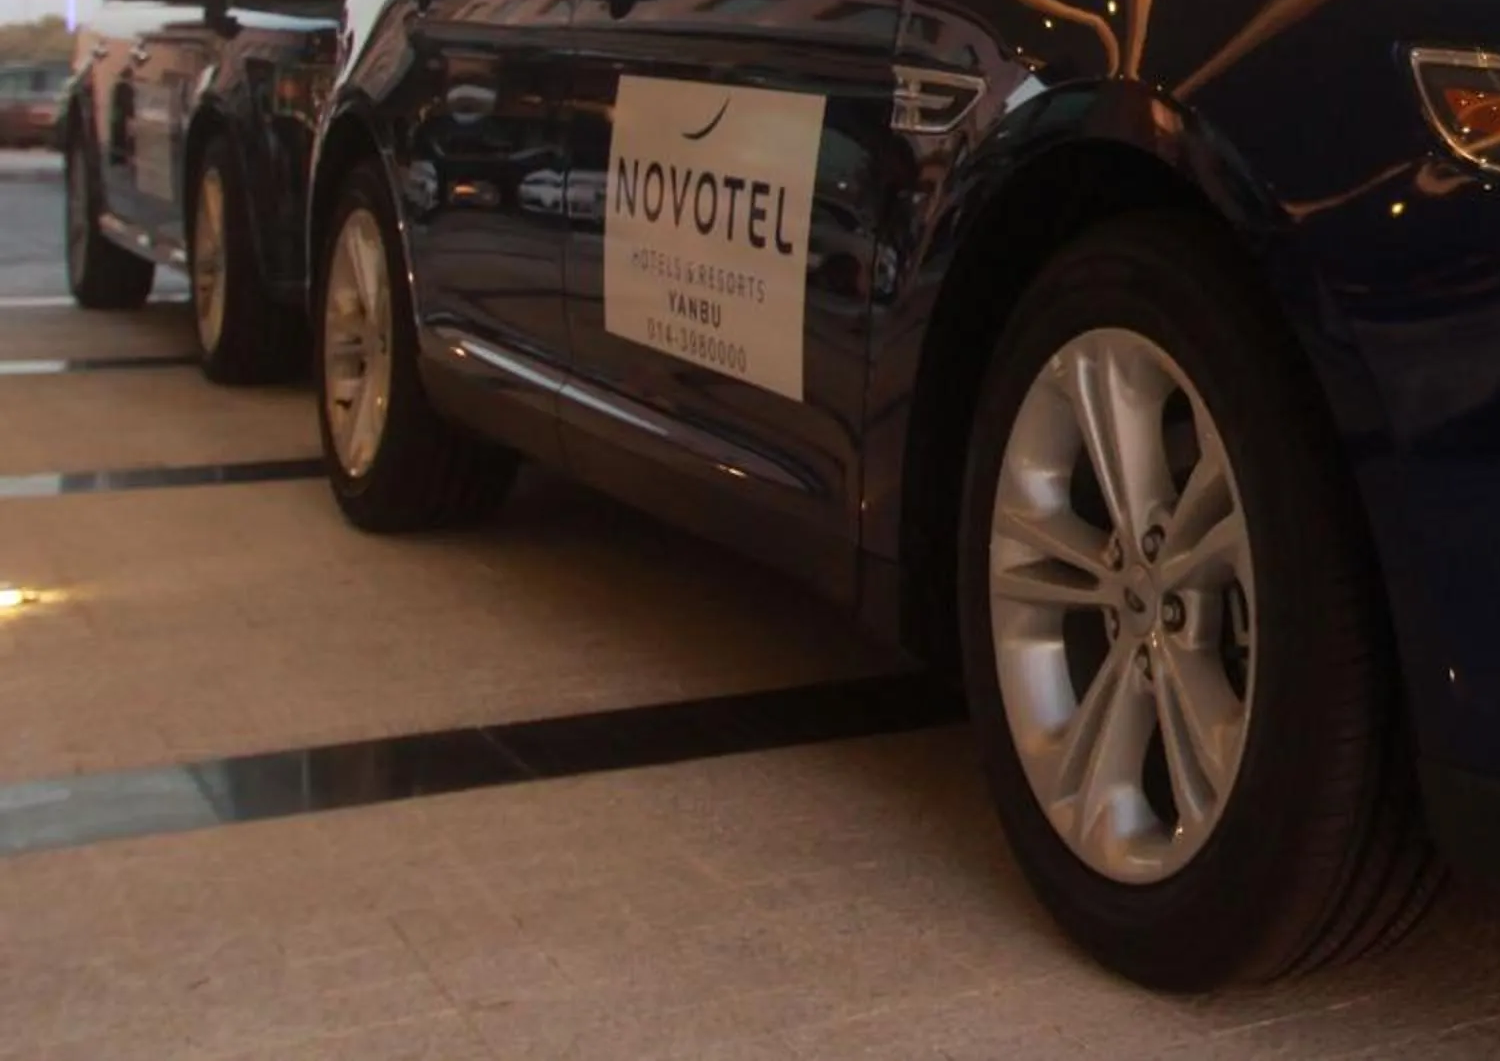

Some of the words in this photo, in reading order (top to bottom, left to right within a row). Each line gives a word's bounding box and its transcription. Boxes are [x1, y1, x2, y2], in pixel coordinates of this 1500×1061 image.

[614, 155, 794, 255] NOVOTEL
[632, 248, 682, 282] HOTELS
[698, 264, 767, 304] RESORTS
[668, 288, 722, 329] YANBU
